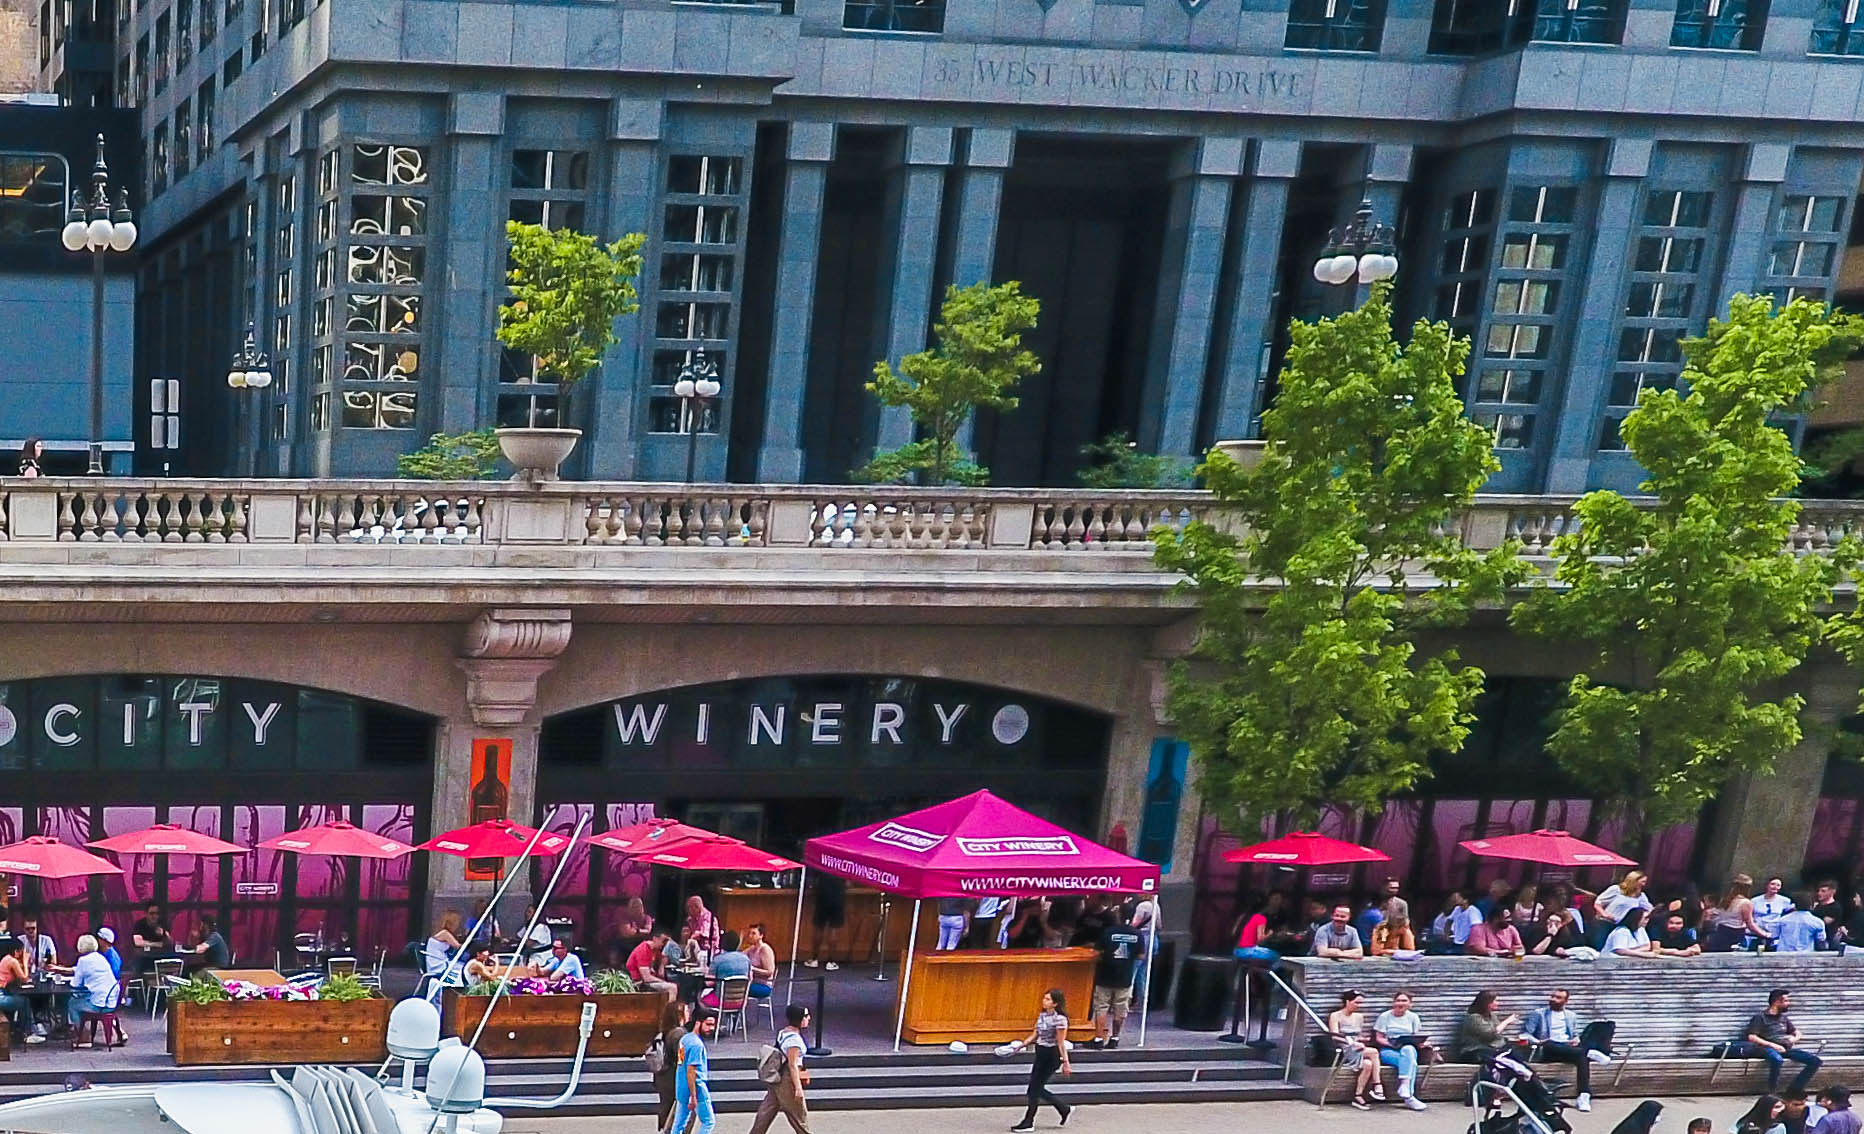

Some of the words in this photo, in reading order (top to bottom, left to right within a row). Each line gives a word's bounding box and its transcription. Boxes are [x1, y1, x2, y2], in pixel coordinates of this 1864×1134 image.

[934, 58, 960, 83] 35
[977, 59, 1058, 87] WEST
[1076, 63, 1200, 92] WACKER
[1213, 68, 1303, 98] DRIVE
[44, 702, 282, 747] CITY
[614, 703, 970, 746] WINERY
[967, 843, 1000, 851] CITY
[1003, 841, 1065, 851] WINERY
[961, 876, 1121, 891] WWW.CITYWINERY.COM
